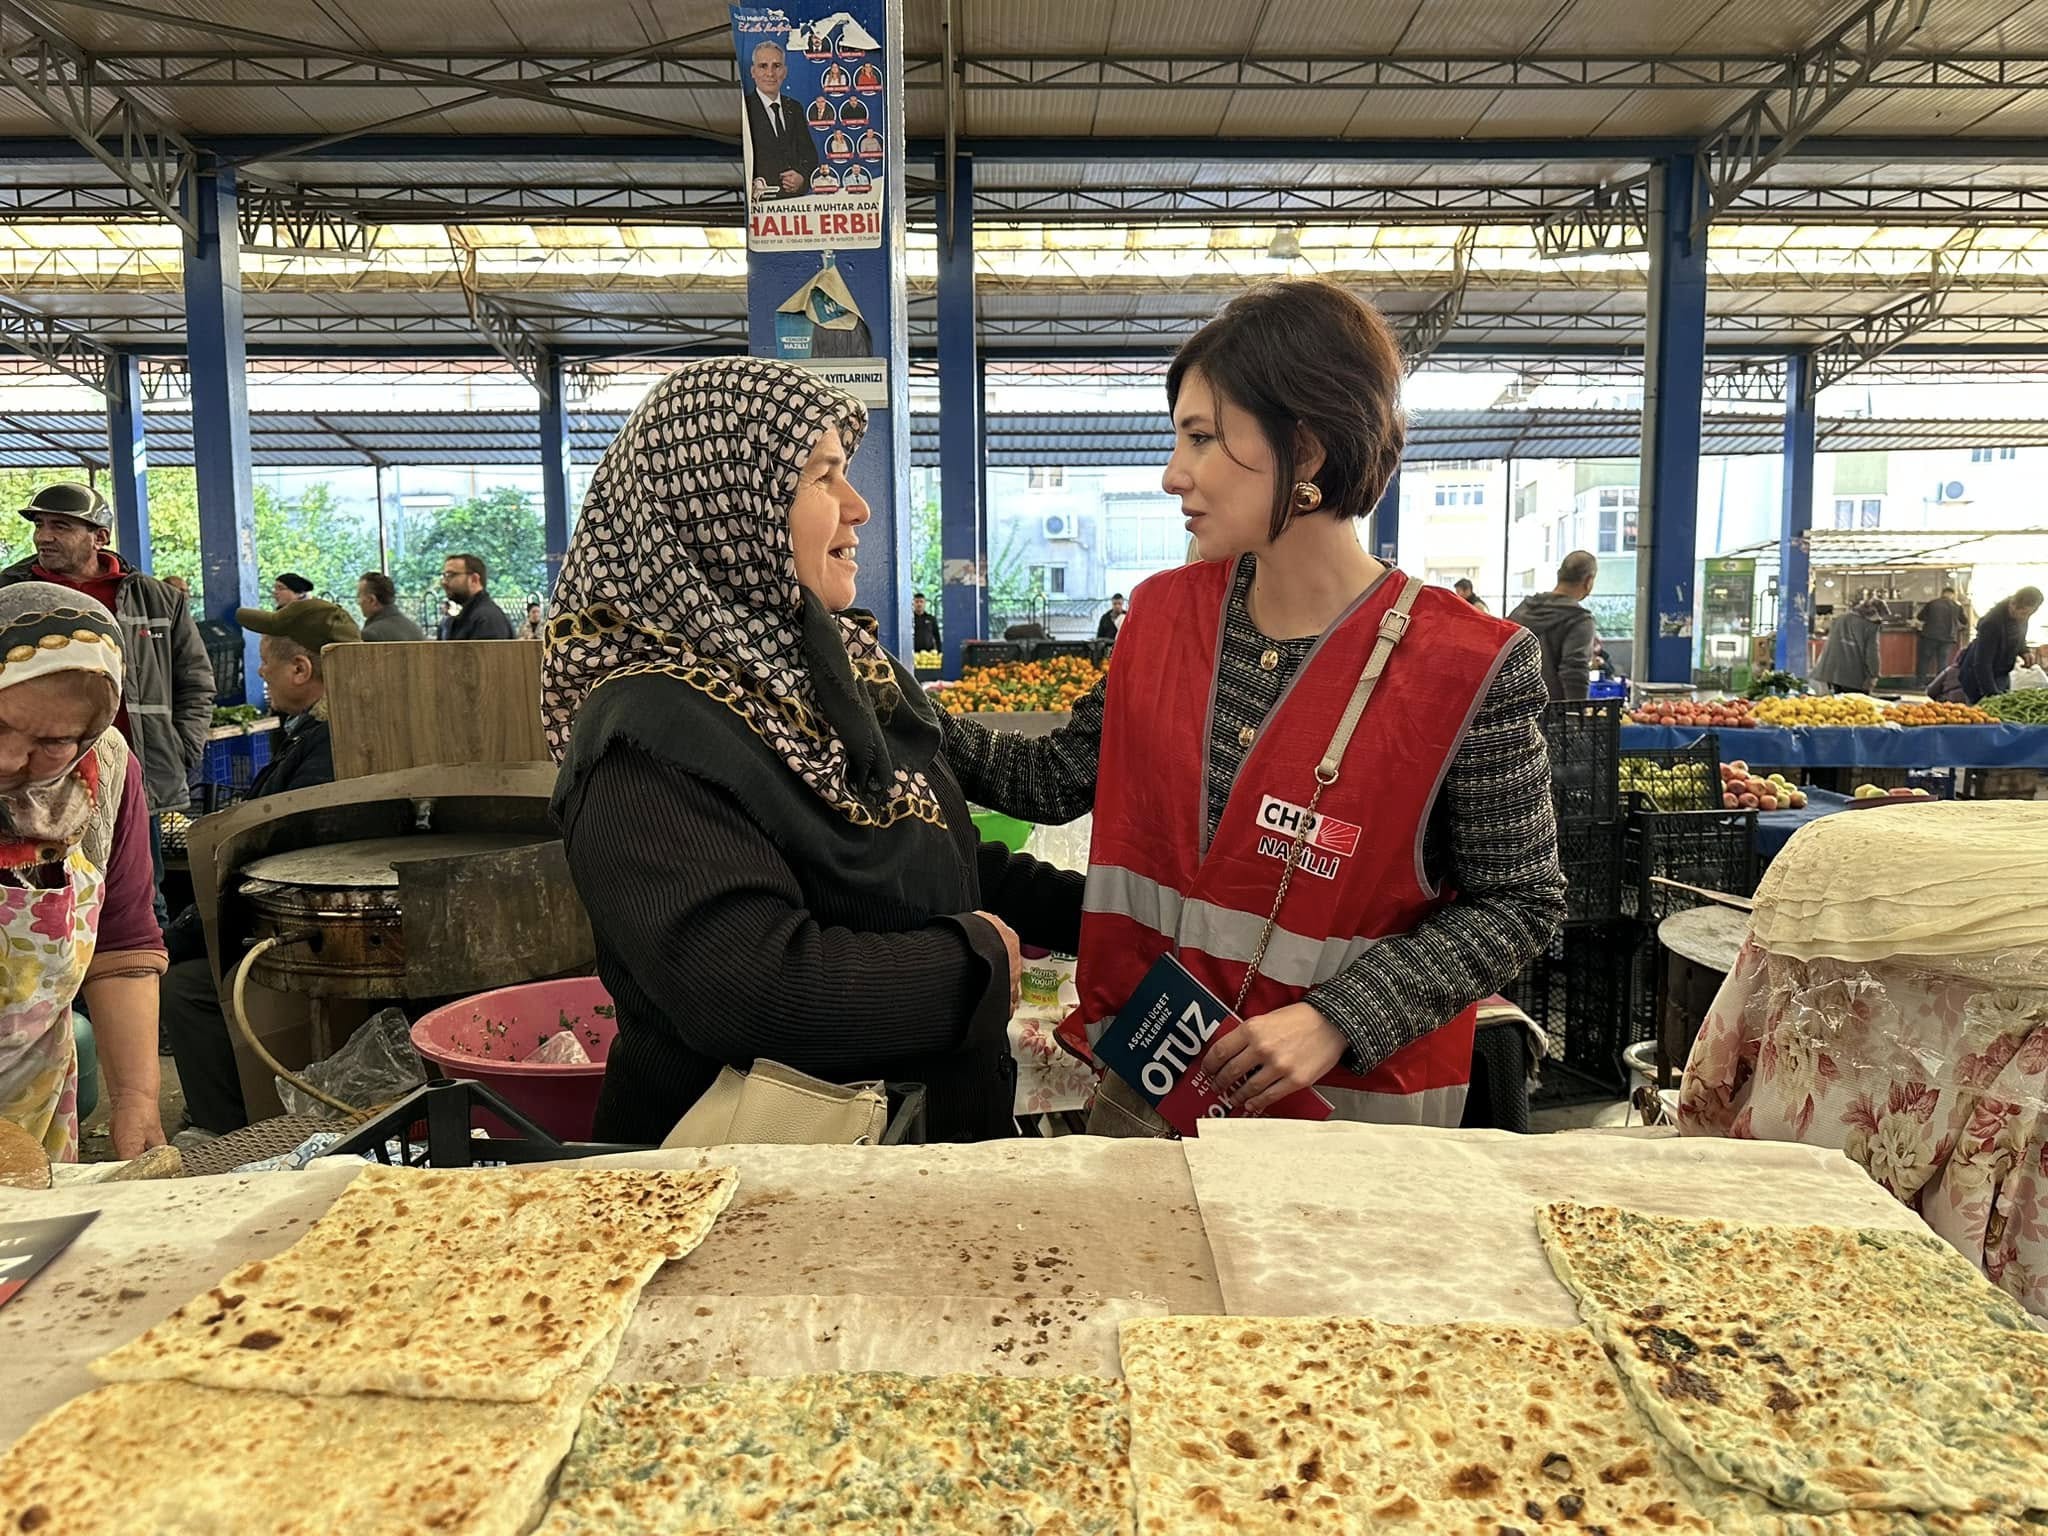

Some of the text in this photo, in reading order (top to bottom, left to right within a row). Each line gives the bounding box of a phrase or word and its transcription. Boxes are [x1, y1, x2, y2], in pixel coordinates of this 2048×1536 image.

[766, 203, 811, 213] MAHALLE
[814, 202, 854, 212] MUHTAR
[1258, 836, 1340, 880] NAİLLİ
[1148, 992, 1170, 1020] ÜCRET
[1140, 1007, 1173, 1048] TALEBİMİZ
[1141, 1000, 1221, 1096] OTUZ
